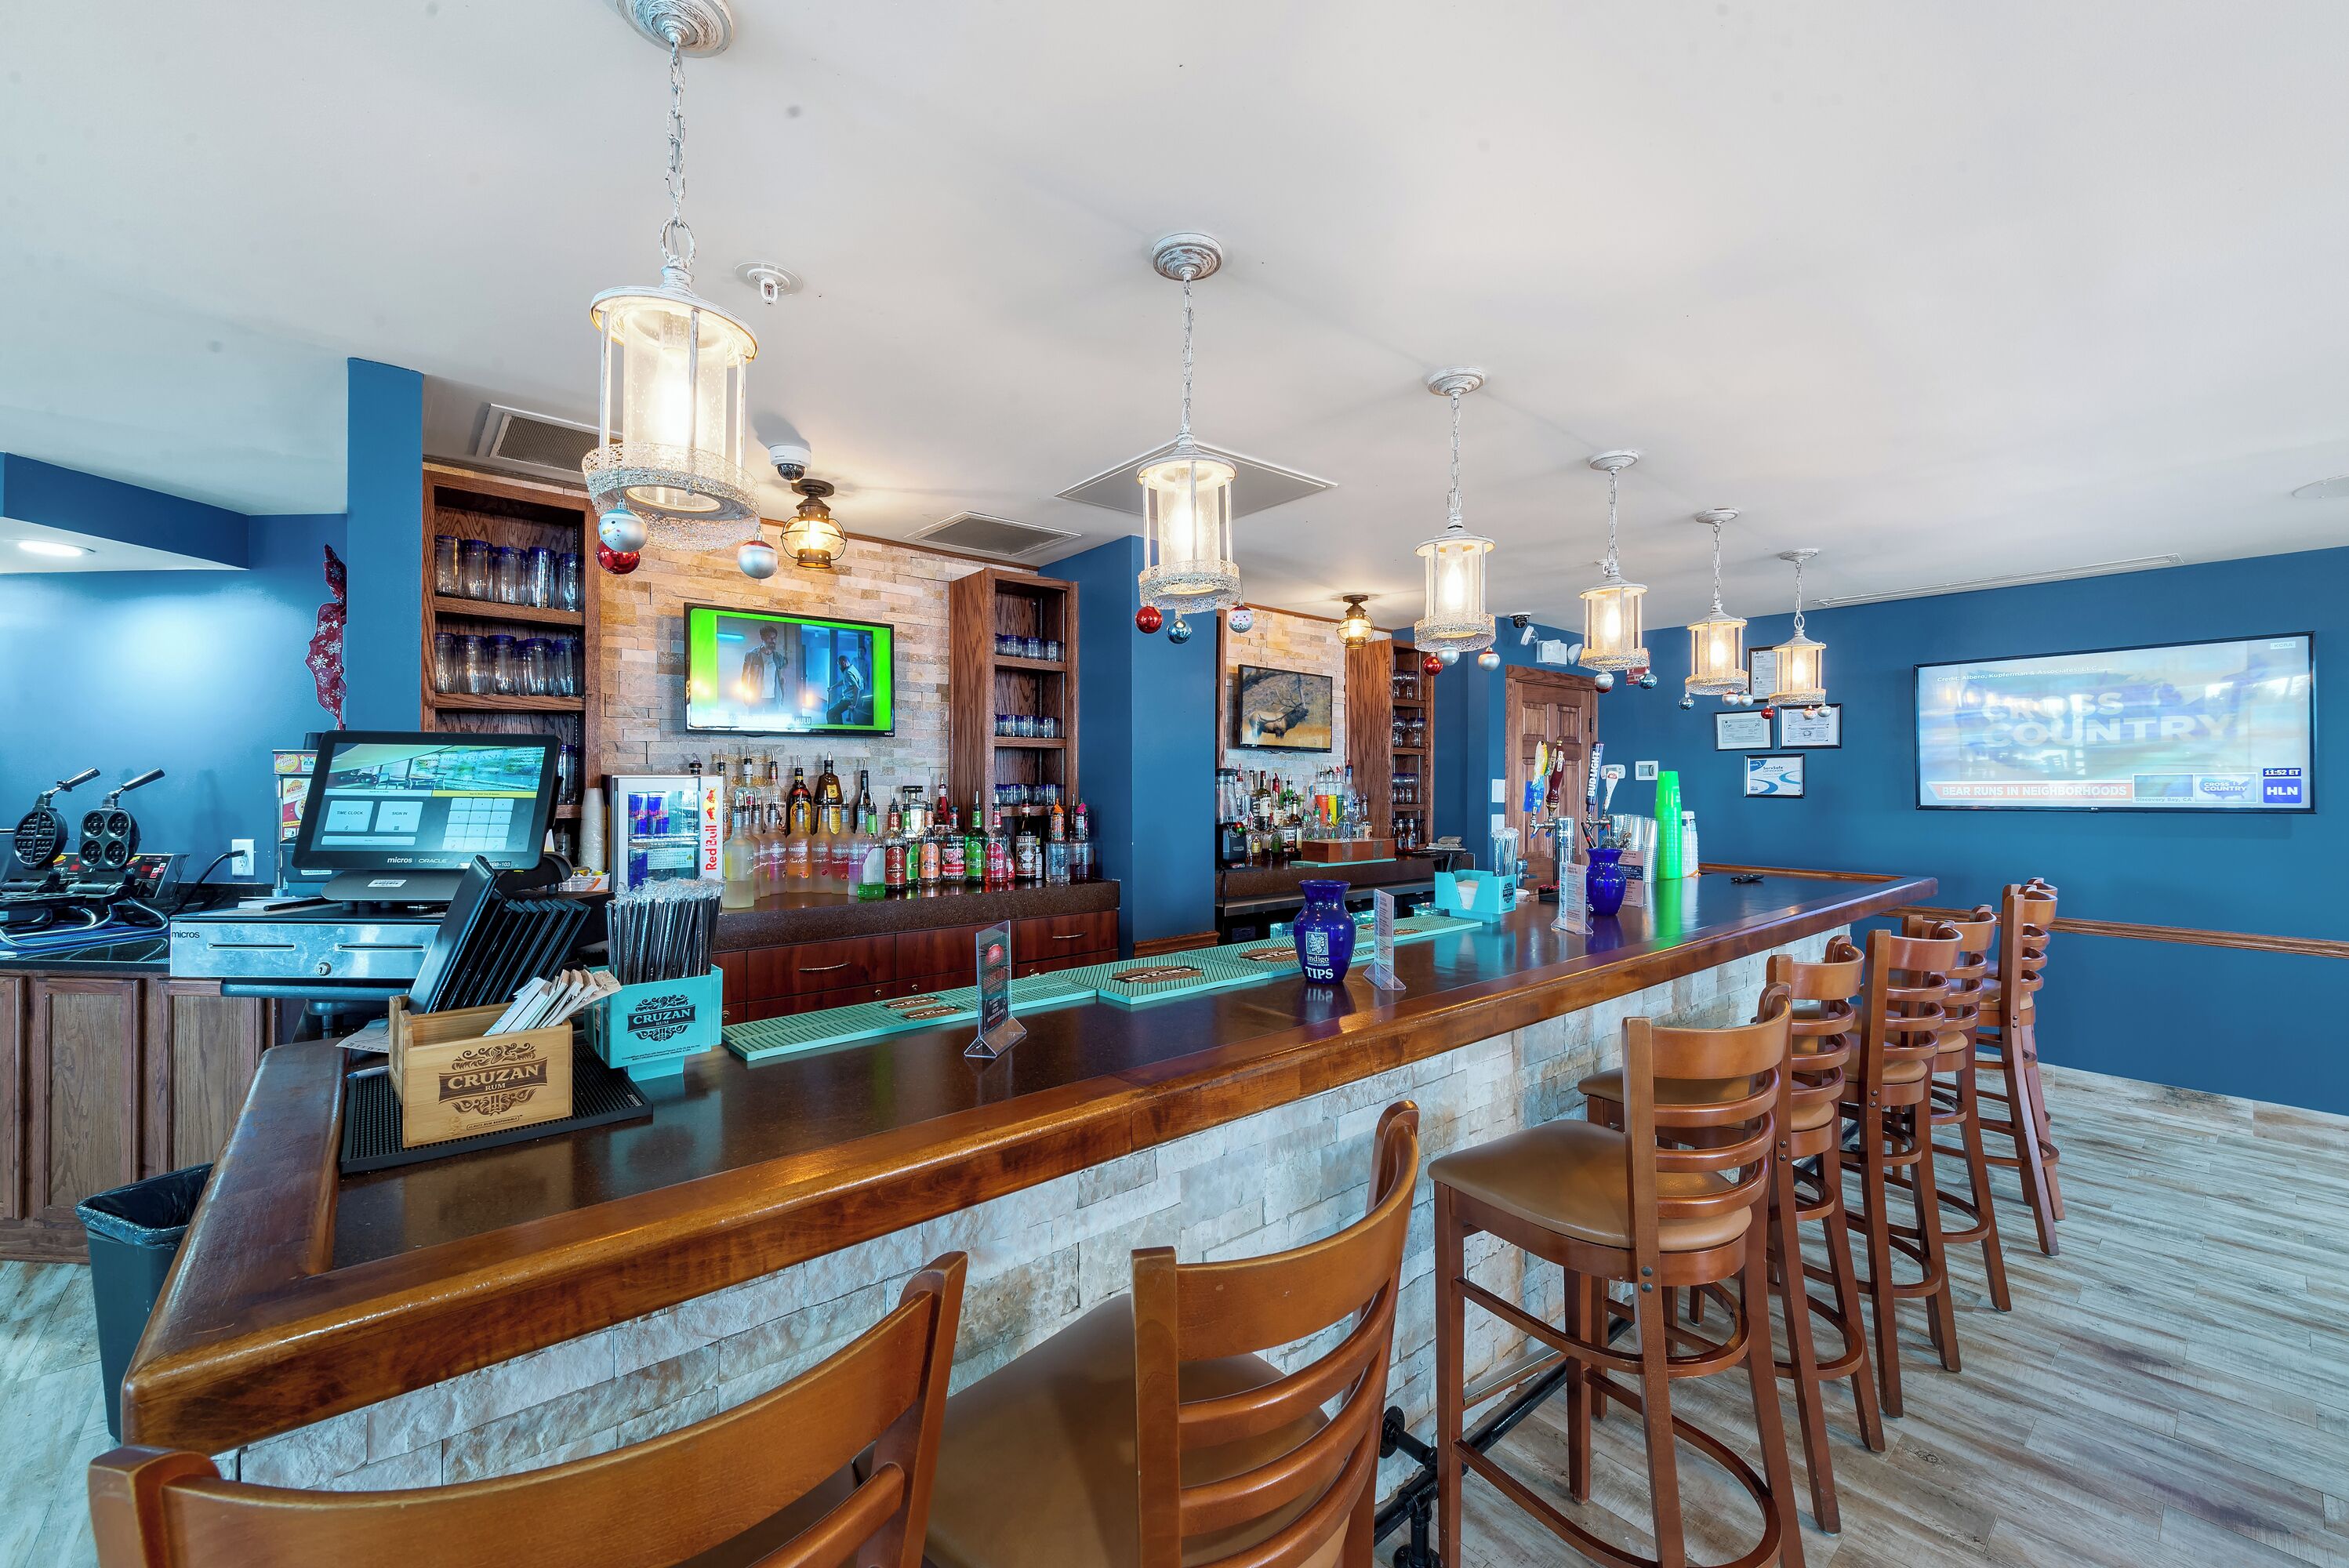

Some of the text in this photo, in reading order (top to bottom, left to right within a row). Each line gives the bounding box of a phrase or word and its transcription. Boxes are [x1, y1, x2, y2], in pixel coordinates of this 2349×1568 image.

[1981, 691, 2124, 721] CROSS
[1982, 713, 2231, 747] COUNTRY
[1587, 750, 1600, 797] BUD LIGHT
[1942, 786, 2127, 797] BEAR RUNS IN NEIGHBORHOODS
[2267, 786, 2299, 796] HLN
[705, 825, 717, 871] Red Bull
[171, 930, 201, 938] micros
[1307, 954, 1330, 964] indigo
[1305, 966, 1334, 979] TIPS
[633, 1008, 691, 1025] CRUZAN
[448, 1064, 540, 1090] CRUZAN
[485, 1083, 506, 1091] RUM
